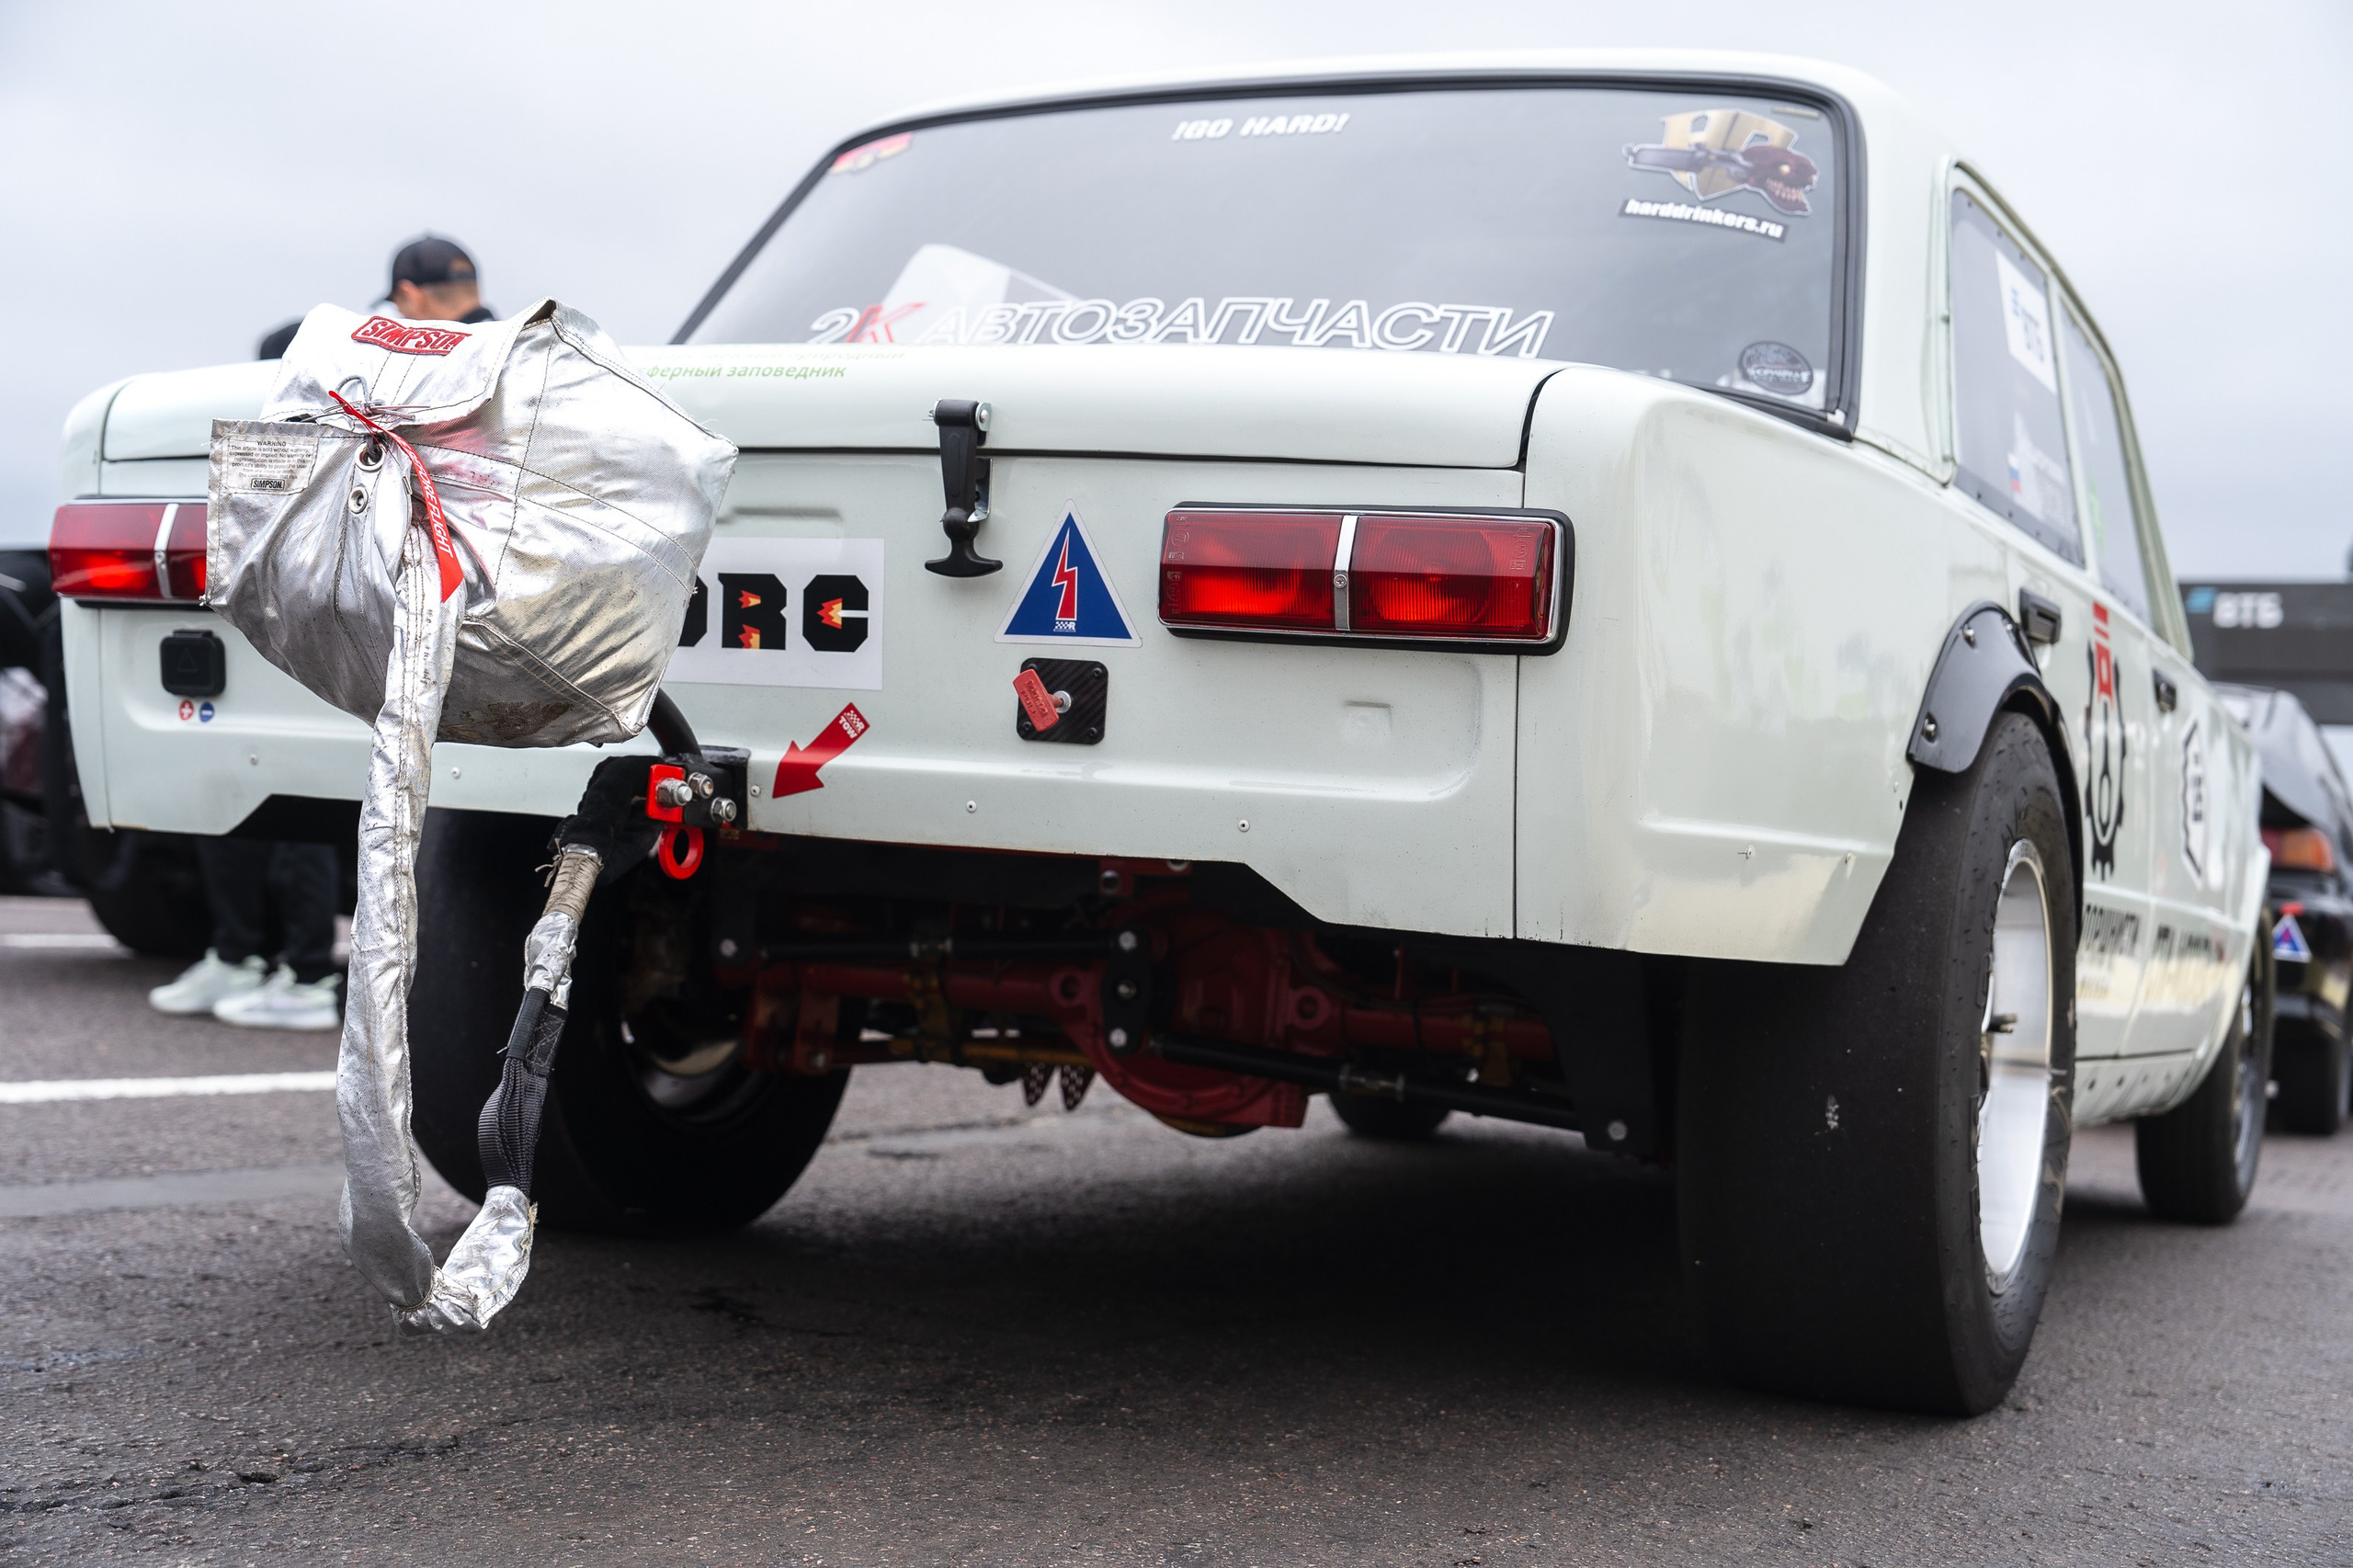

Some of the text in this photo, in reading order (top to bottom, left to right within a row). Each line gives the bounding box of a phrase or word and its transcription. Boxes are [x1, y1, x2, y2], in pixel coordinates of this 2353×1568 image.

[1238, 112, 1351, 138] HARD!
[916, 297, 1556, 359] АВТОЗАПЧАСТИ
[726, 366, 847, 380] заповедник
[427, 502, 454, 558] FLIGHT
[838, 716, 858, 739] TOW
